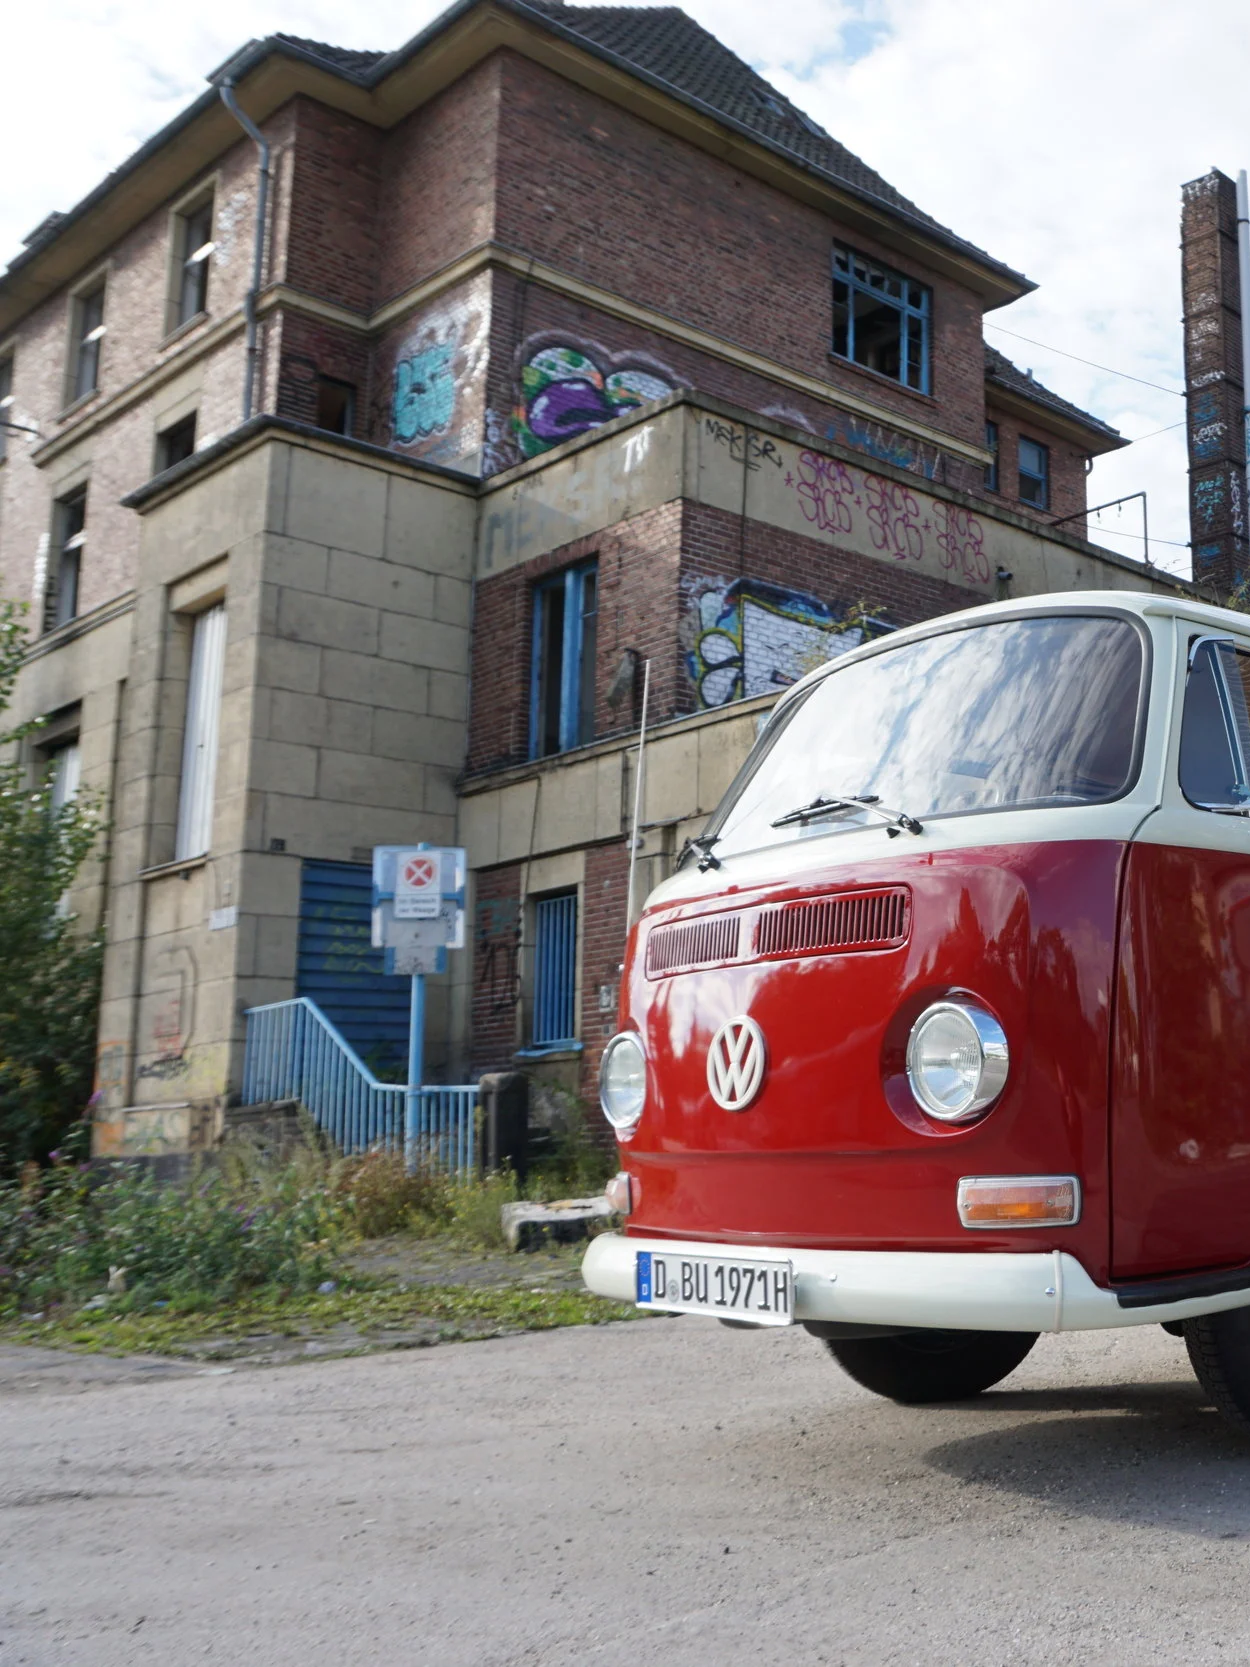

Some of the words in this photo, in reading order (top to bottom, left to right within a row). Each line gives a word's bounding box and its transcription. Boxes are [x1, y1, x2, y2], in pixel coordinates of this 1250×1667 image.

[706, 1014, 765, 1111] VW
[654, 1259, 667, 1299] D
[681, 1261, 709, 1303] BU
[714, 1264, 788, 1314] 1971H
